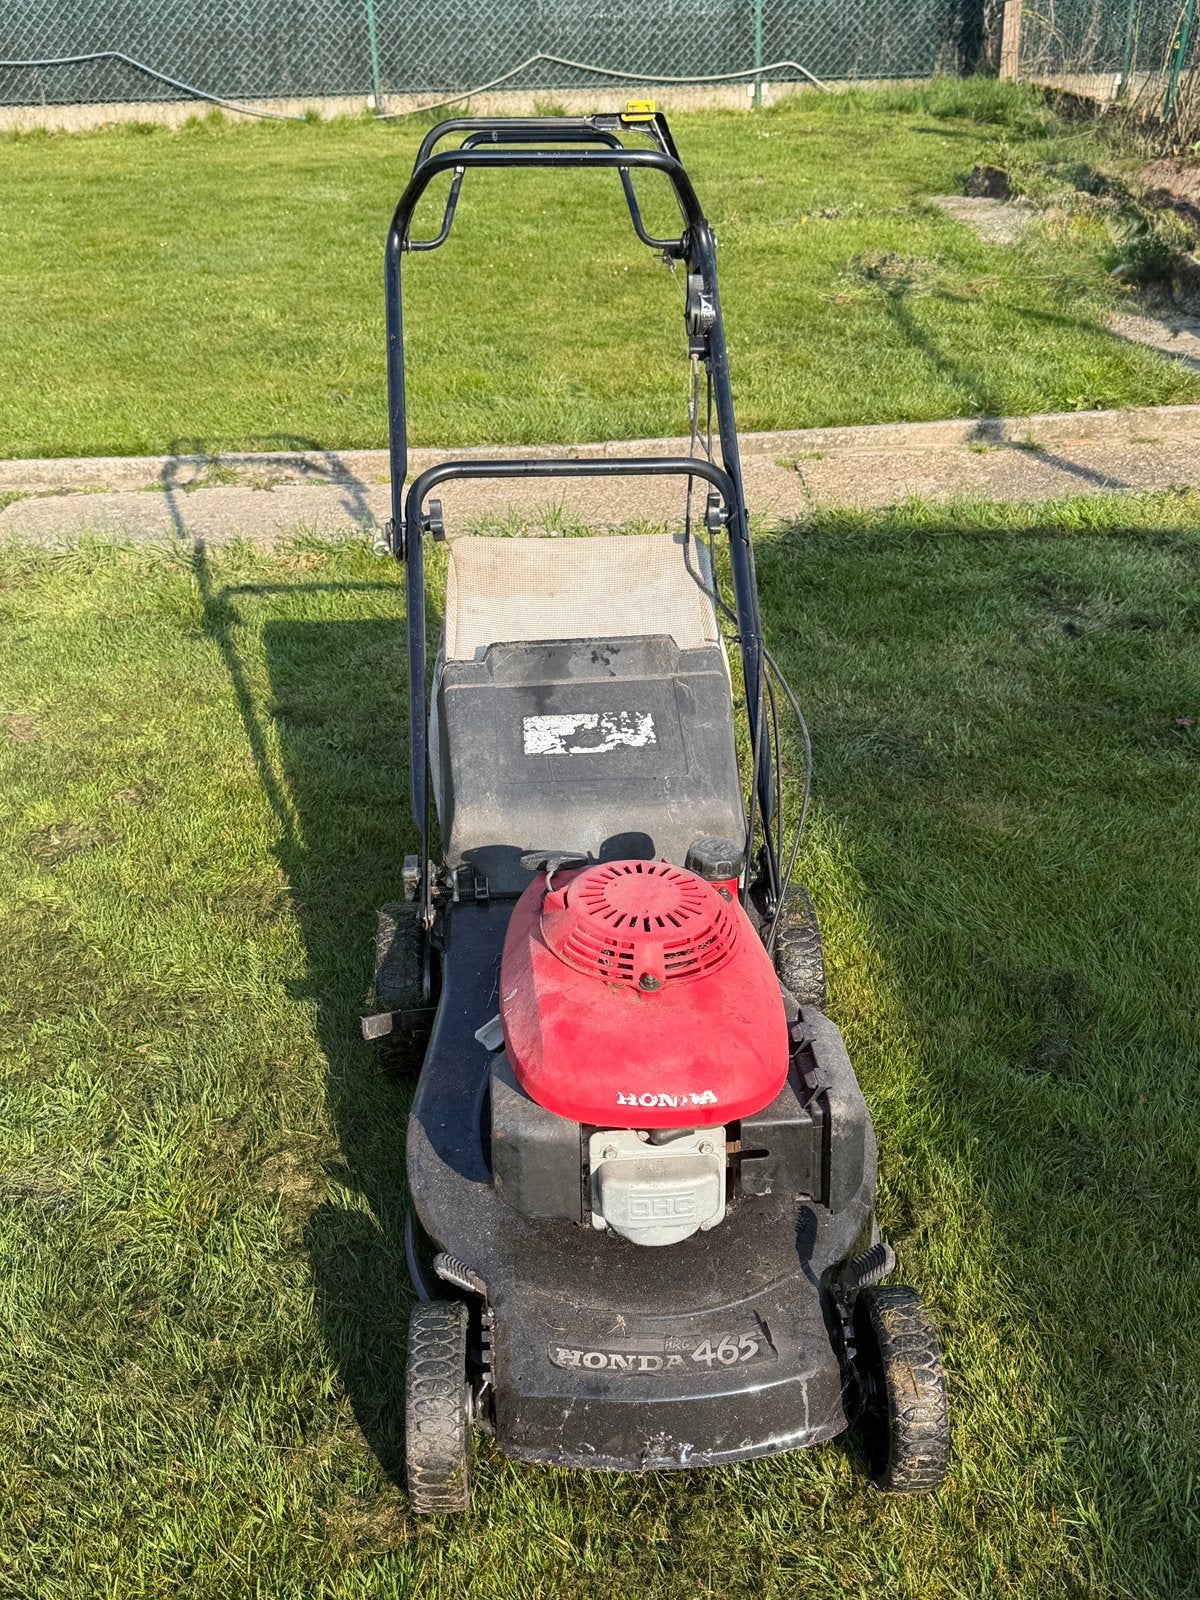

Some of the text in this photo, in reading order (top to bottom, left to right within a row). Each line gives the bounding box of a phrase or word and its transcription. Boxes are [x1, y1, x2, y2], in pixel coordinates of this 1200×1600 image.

[630, 1196, 695, 1215] OHC
[556, 1348, 687, 1371] HONDA
[691, 1331, 763, 1367] 465
